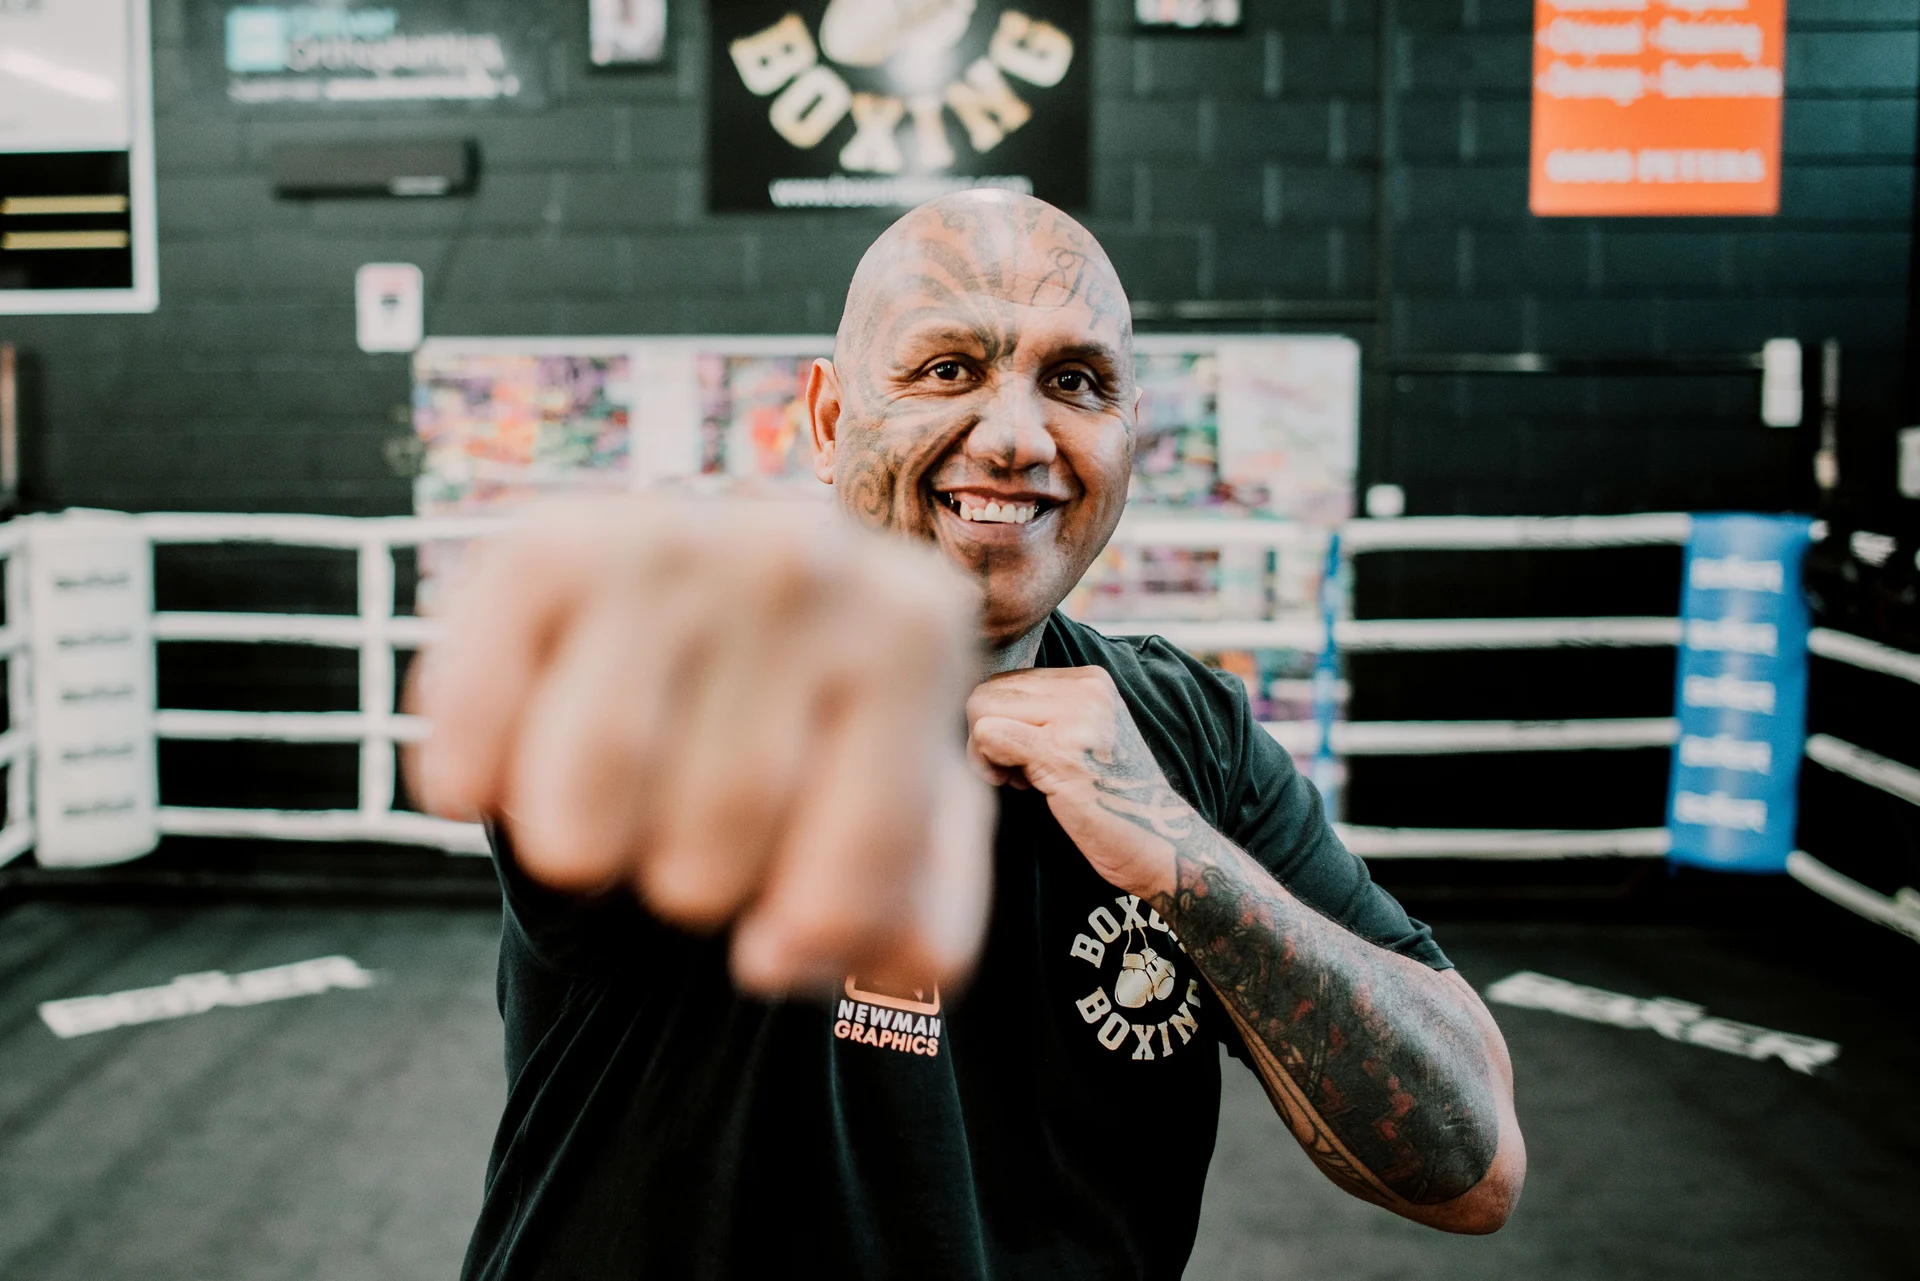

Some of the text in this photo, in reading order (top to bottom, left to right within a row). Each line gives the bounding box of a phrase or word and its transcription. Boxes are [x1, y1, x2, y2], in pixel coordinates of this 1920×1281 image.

[729, 9, 1075, 173] BOXING
[833, 1019, 939, 1057] GRAPHICS
[837, 999, 941, 1038] NEWMAN
